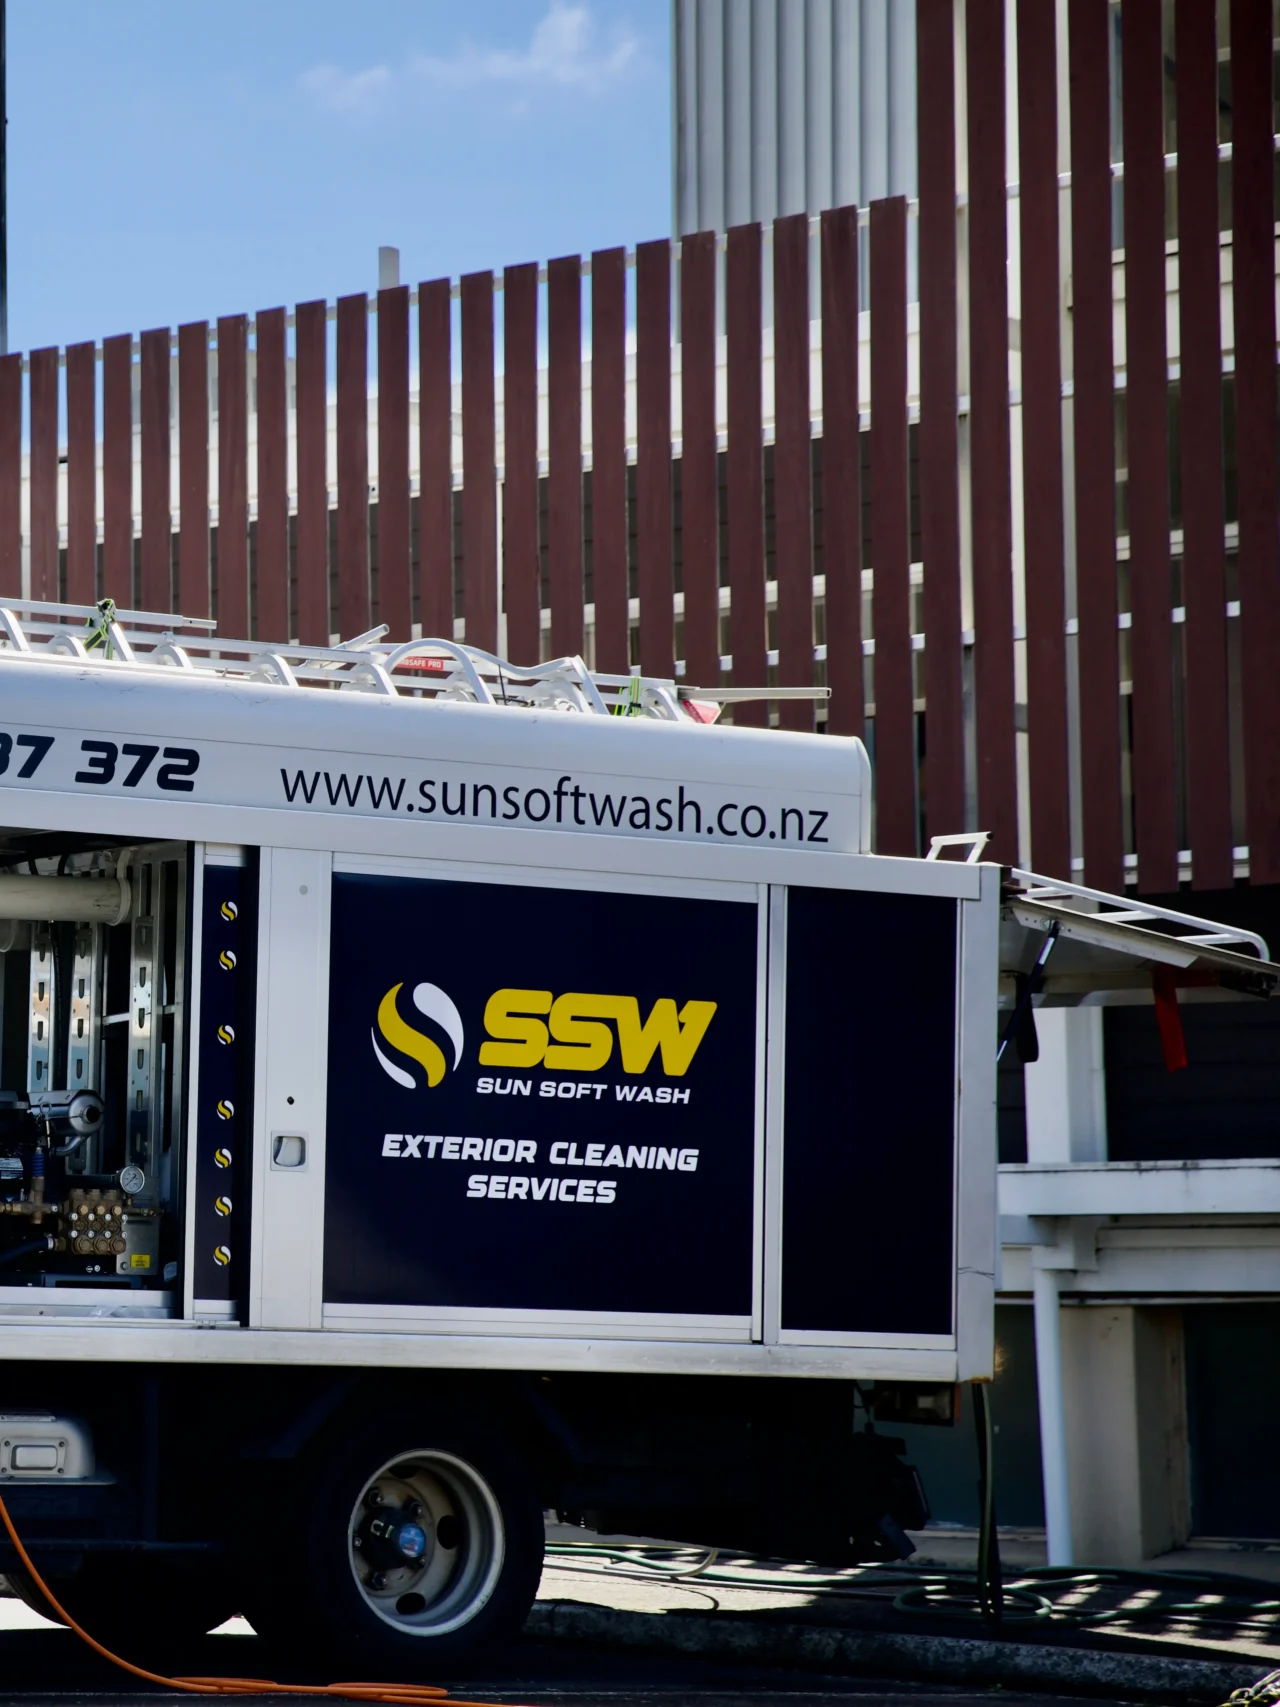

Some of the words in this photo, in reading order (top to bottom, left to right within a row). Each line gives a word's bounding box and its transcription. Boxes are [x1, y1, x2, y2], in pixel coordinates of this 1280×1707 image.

[74, 739, 200, 792] 372
[280, 768, 830, 844] www.sunsoftwash.co.nz
[478, 988, 718, 1076] SSW
[476, 1077, 532, 1096] SUN
[539, 1081, 608, 1100] SOFT
[615, 1085, 690, 1104] WASH
[382, 1133, 537, 1164] EXTERIOR
[549, 1142, 699, 1171] CLEANING
[466, 1174, 617, 1203] SERVICES
